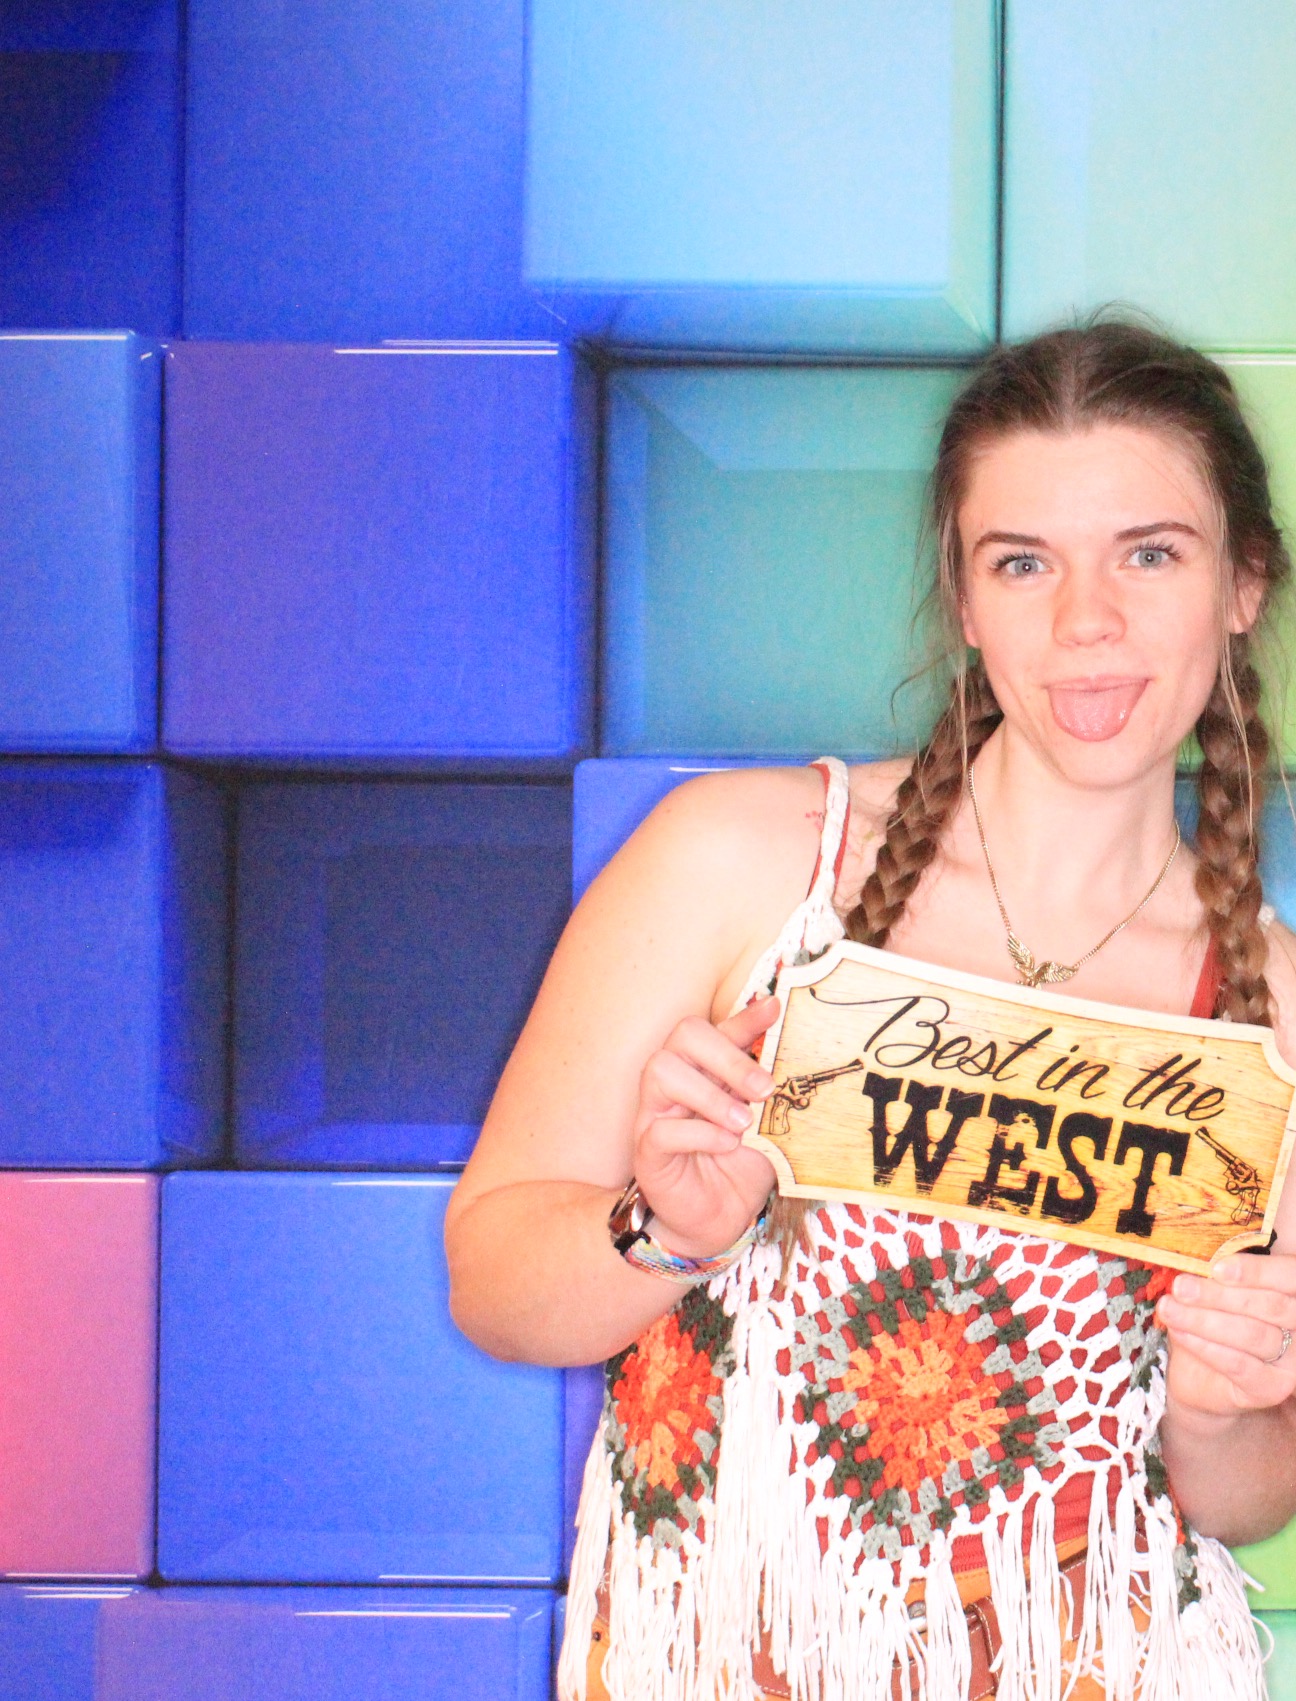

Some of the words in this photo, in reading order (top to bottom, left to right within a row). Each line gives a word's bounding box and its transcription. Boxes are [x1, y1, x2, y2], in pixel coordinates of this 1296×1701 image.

[809, 986, 1054, 1083] Best
[1037, 1043, 1108, 1099] in
[1123, 1053, 1225, 1122] the
[861, 1071, 1191, 1238] WEST
